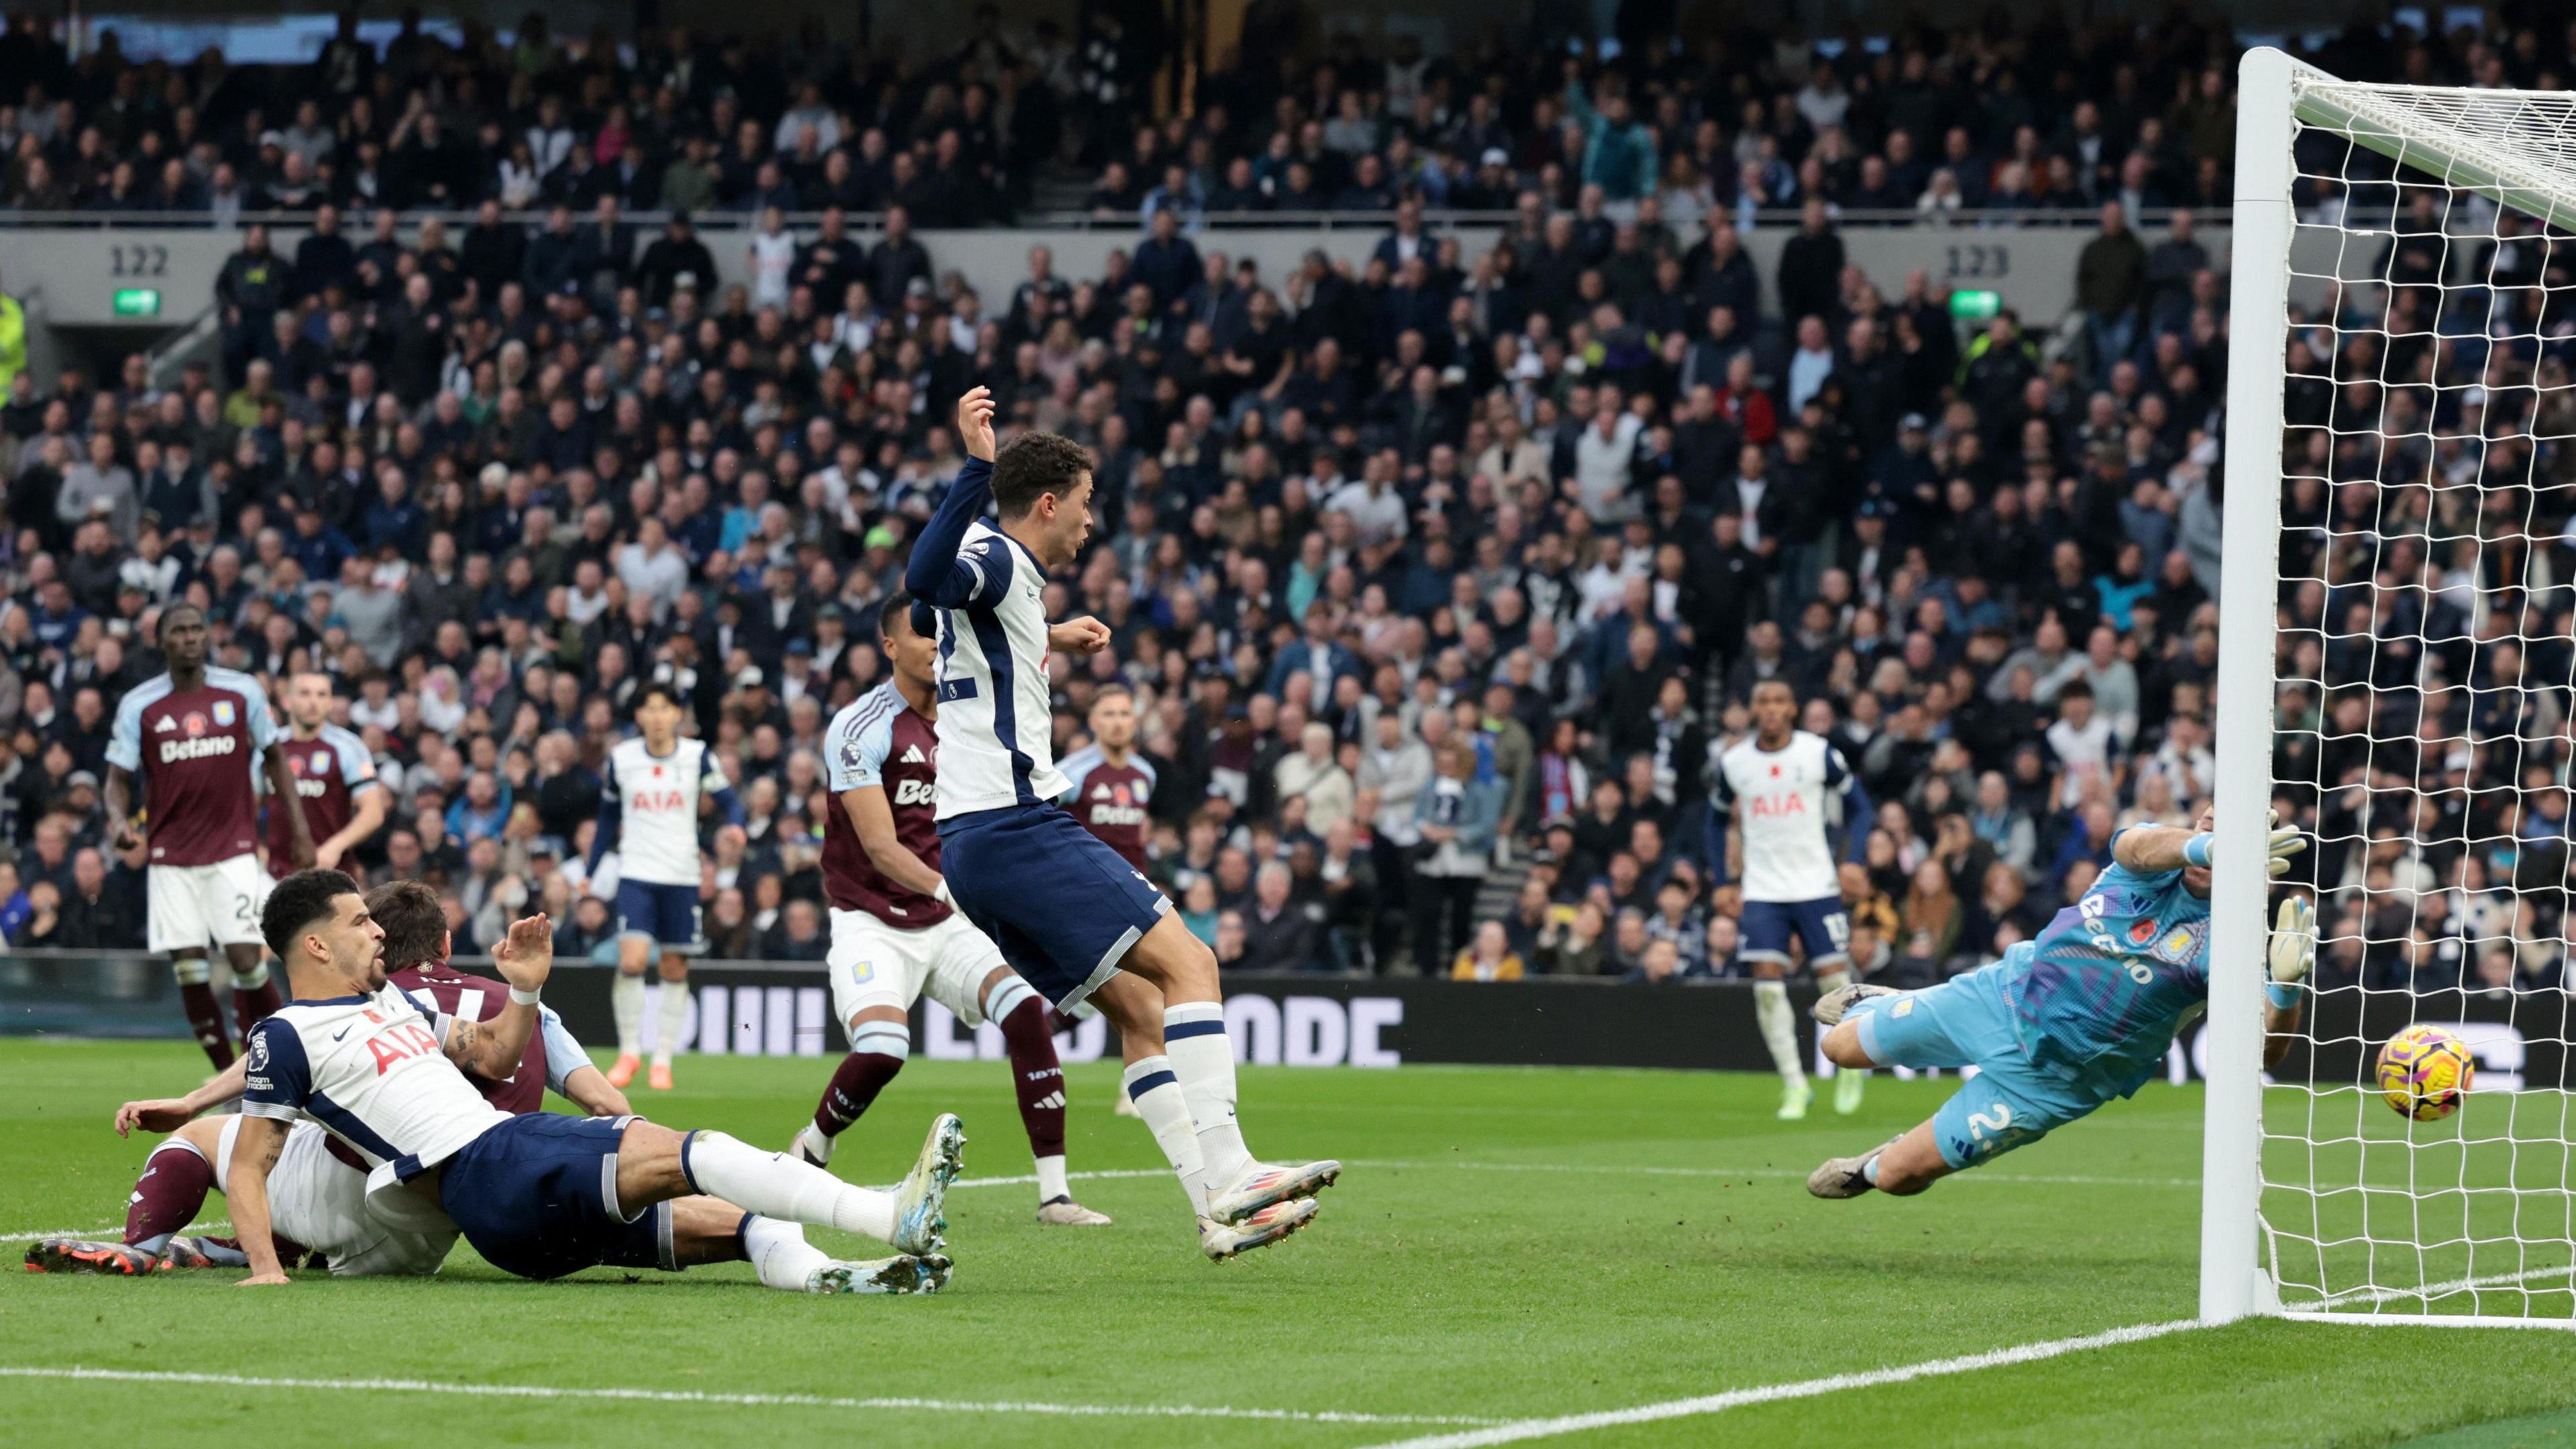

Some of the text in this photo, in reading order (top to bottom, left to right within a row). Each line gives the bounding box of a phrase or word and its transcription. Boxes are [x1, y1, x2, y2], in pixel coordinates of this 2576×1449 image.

[110, 246, 168, 276] 122
[1948, 246, 2009, 276] 123
[160, 735, 236, 763] Betano
[632, 790, 686, 811] AIA
[1752, 791, 1807, 818] AIA
[366, 1025, 440, 1077] AIA
